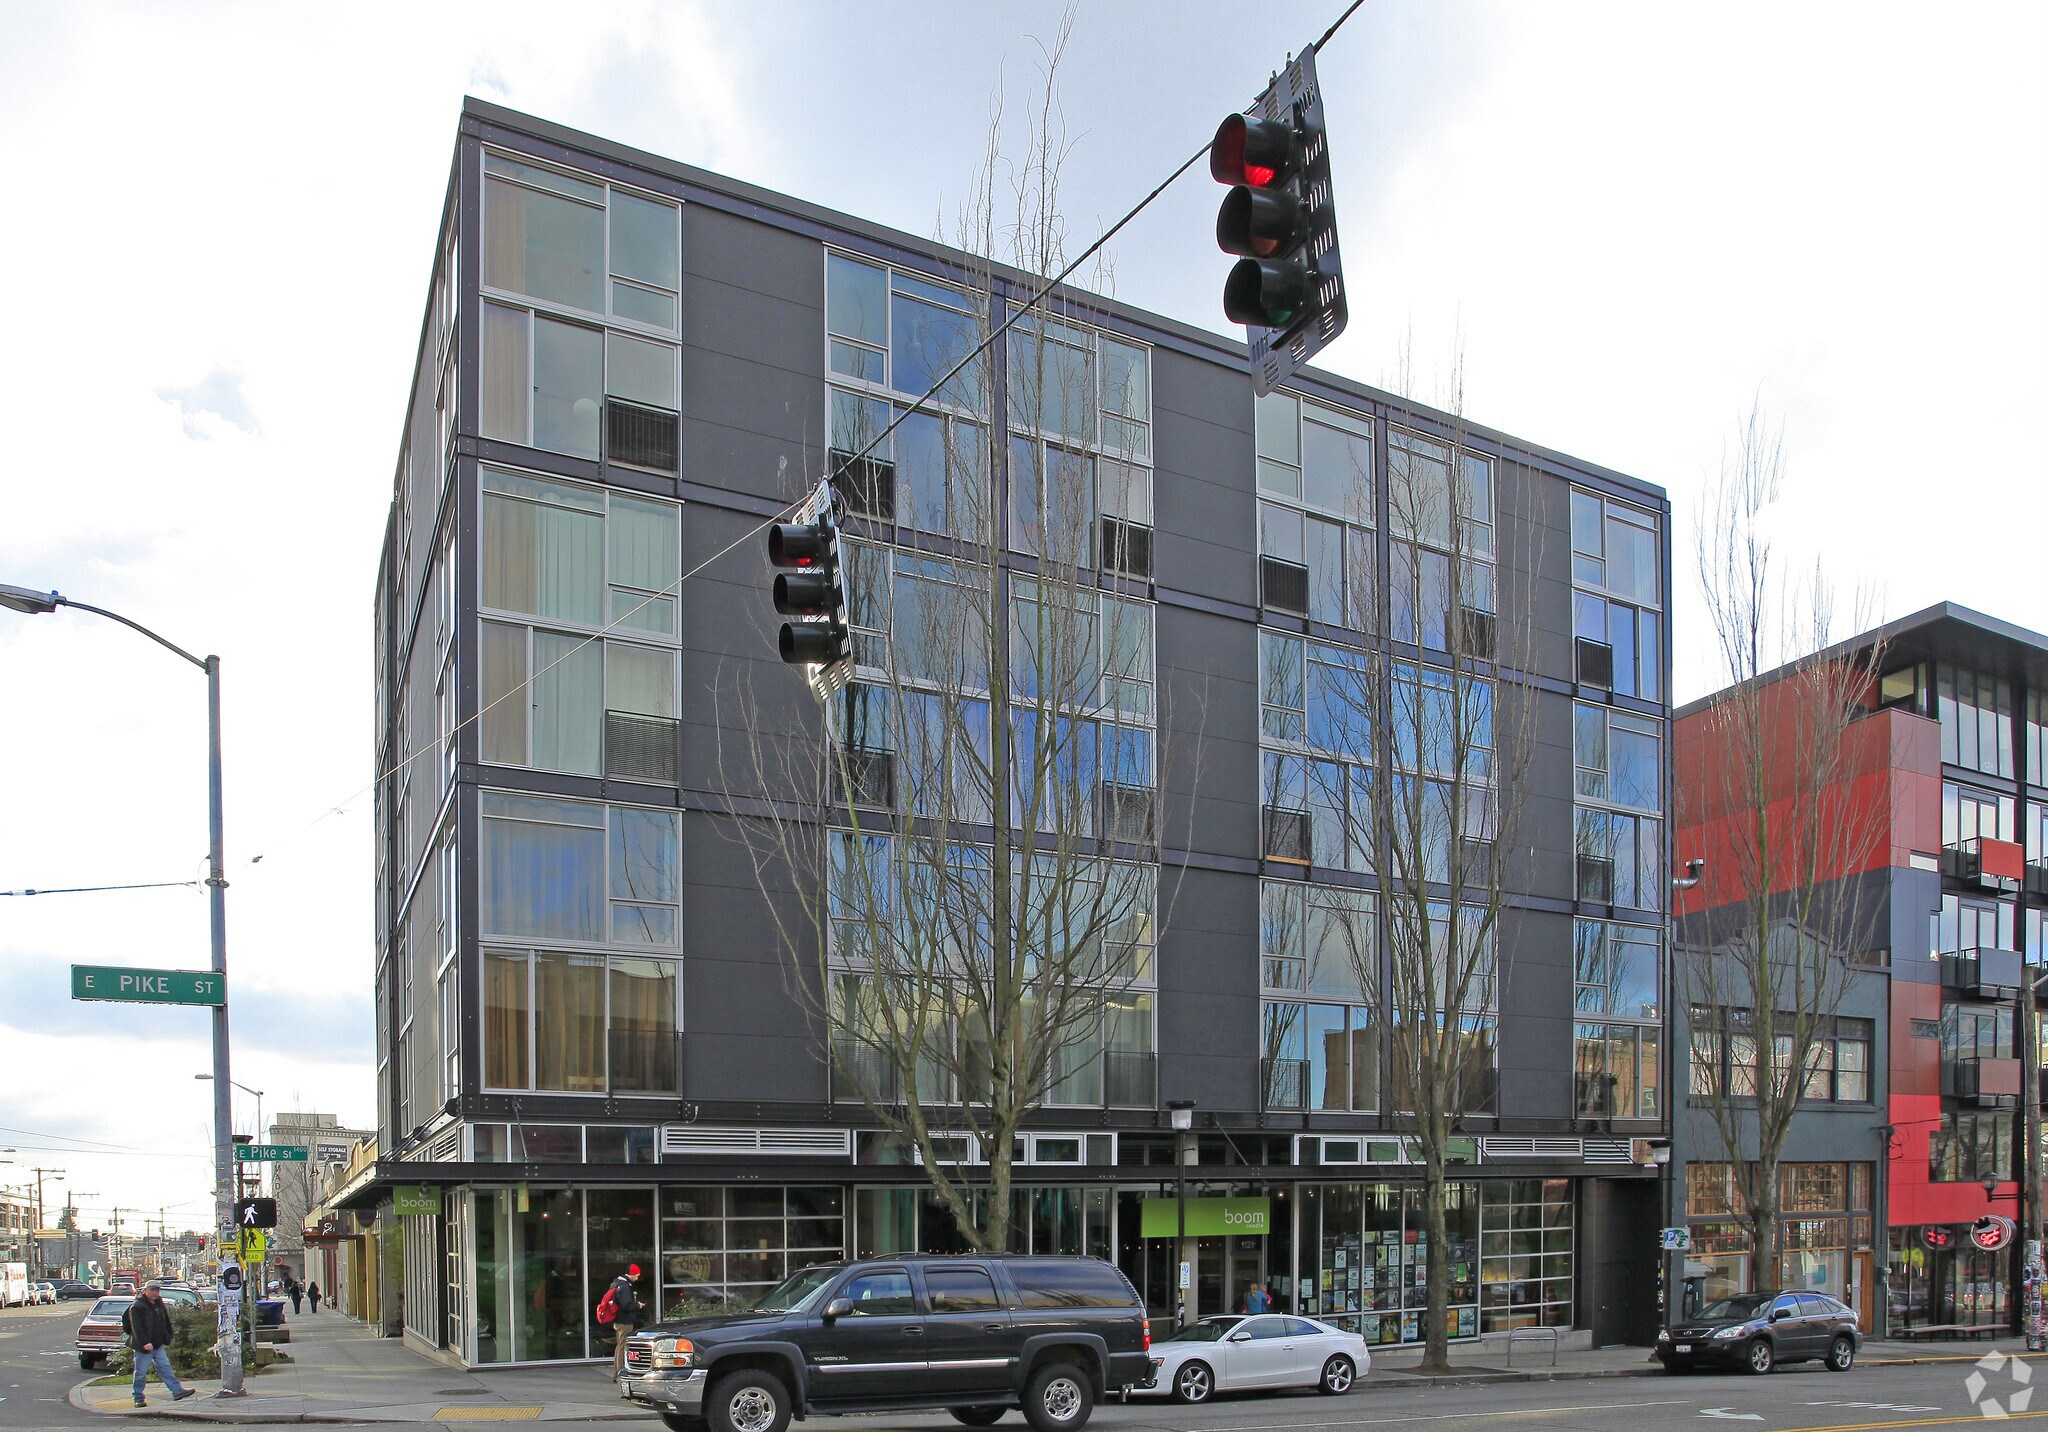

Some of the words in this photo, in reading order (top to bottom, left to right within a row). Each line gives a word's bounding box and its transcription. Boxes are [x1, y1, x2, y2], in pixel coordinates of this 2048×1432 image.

[85, 975, 95, 988] E
[120, 975, 170, 994] PIKE
[194, 980, 214, 994] ST
[240, 1149, 246, 1158] E
[251, 1146, 277, 1159] Pike
[282, 1149, 293, 1159] St
[401, 1196, 436, 1207] boom
[1224, 1208, 1264, 1224] boom
[1667, 1231, 1675, 1240] P
